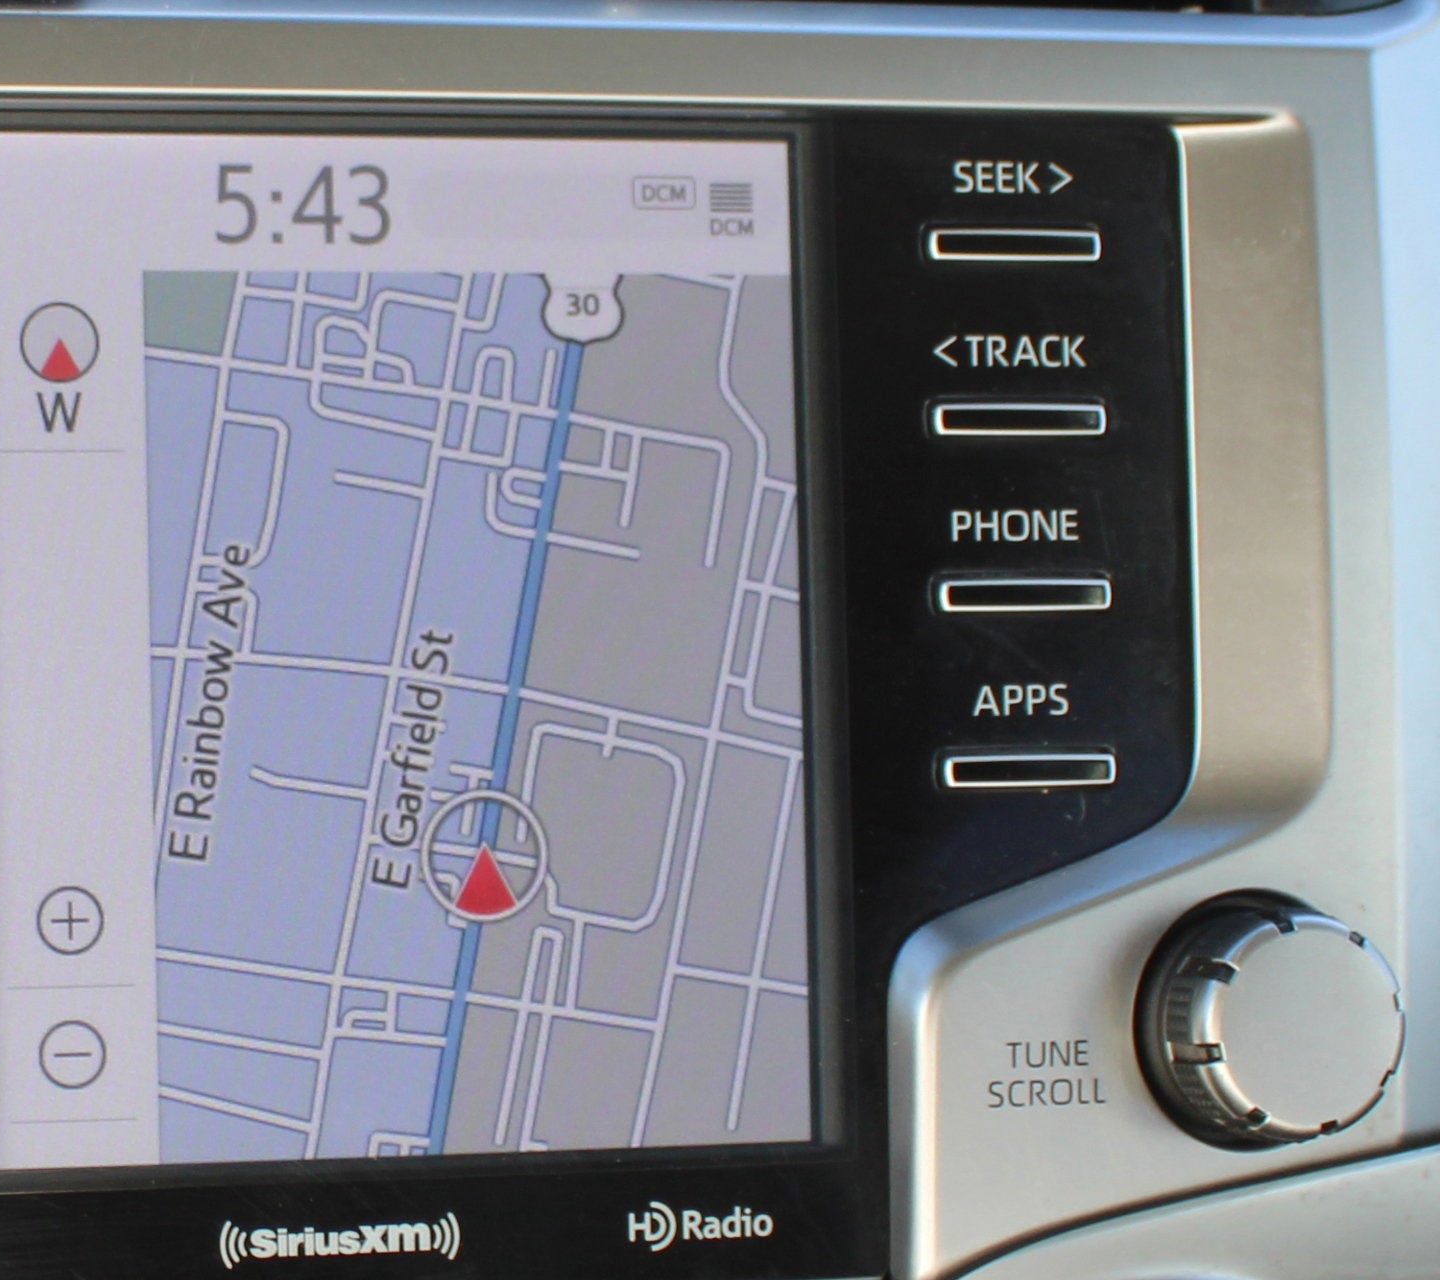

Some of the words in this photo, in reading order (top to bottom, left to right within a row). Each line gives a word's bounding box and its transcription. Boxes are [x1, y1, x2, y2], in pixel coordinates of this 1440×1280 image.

[214, 163, 392, 246] 5:43
[641, 185, 687, 203] DCM
[710, 218, 755, 236] DCM
[565, 292, 602, 319] 30
[36, 392, 82, 434] W
[951, 510, 1080, 542] PHONE
[202, 543, 252, 629] Ave
[413, 628, 455, 679] St
[972, 683, 1070, 717] APPS
[174, 641, 237, 824] Rainbow
[379, 682, 445, 850] Garfield
[169, 830, 209, 863] E
[372, 859, 413, 891] E
[1006, 1039, 1090, 1070] TUNE
[987, 1077, 1107, 1109] SCROLL
[682, 1208, 774, 1240] Radio
